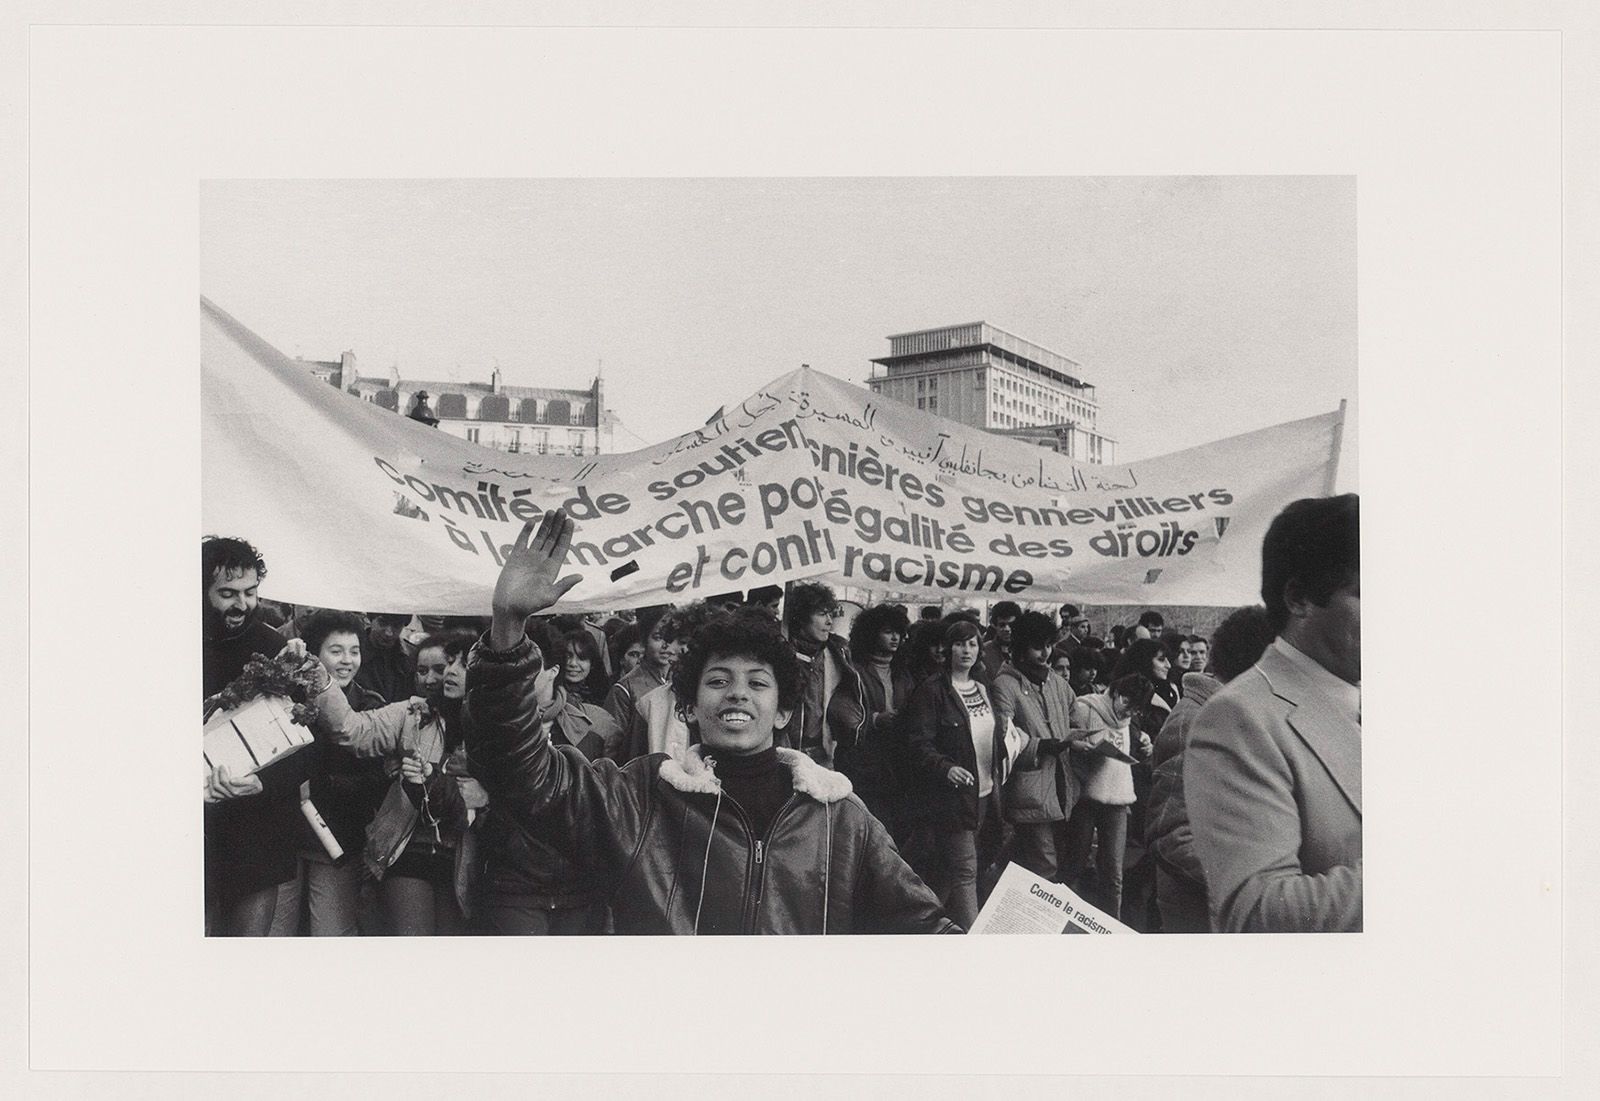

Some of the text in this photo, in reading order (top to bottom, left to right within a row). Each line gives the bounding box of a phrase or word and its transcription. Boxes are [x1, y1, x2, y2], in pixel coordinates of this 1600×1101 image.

[562, 486, 631, 521] de
[647, 418, 809, 501] soutien
[961, 488, 1234, 526] gennevilliers
[988, 533, 1074, 558] des
[1089, 521, 1199, 558] droits
[665, 544, 711, 593] et
[843, 545, 1034, 594] racisme
[1029, 883, 1063, 909] Contre
[1062, 901, 1074, 915] le
